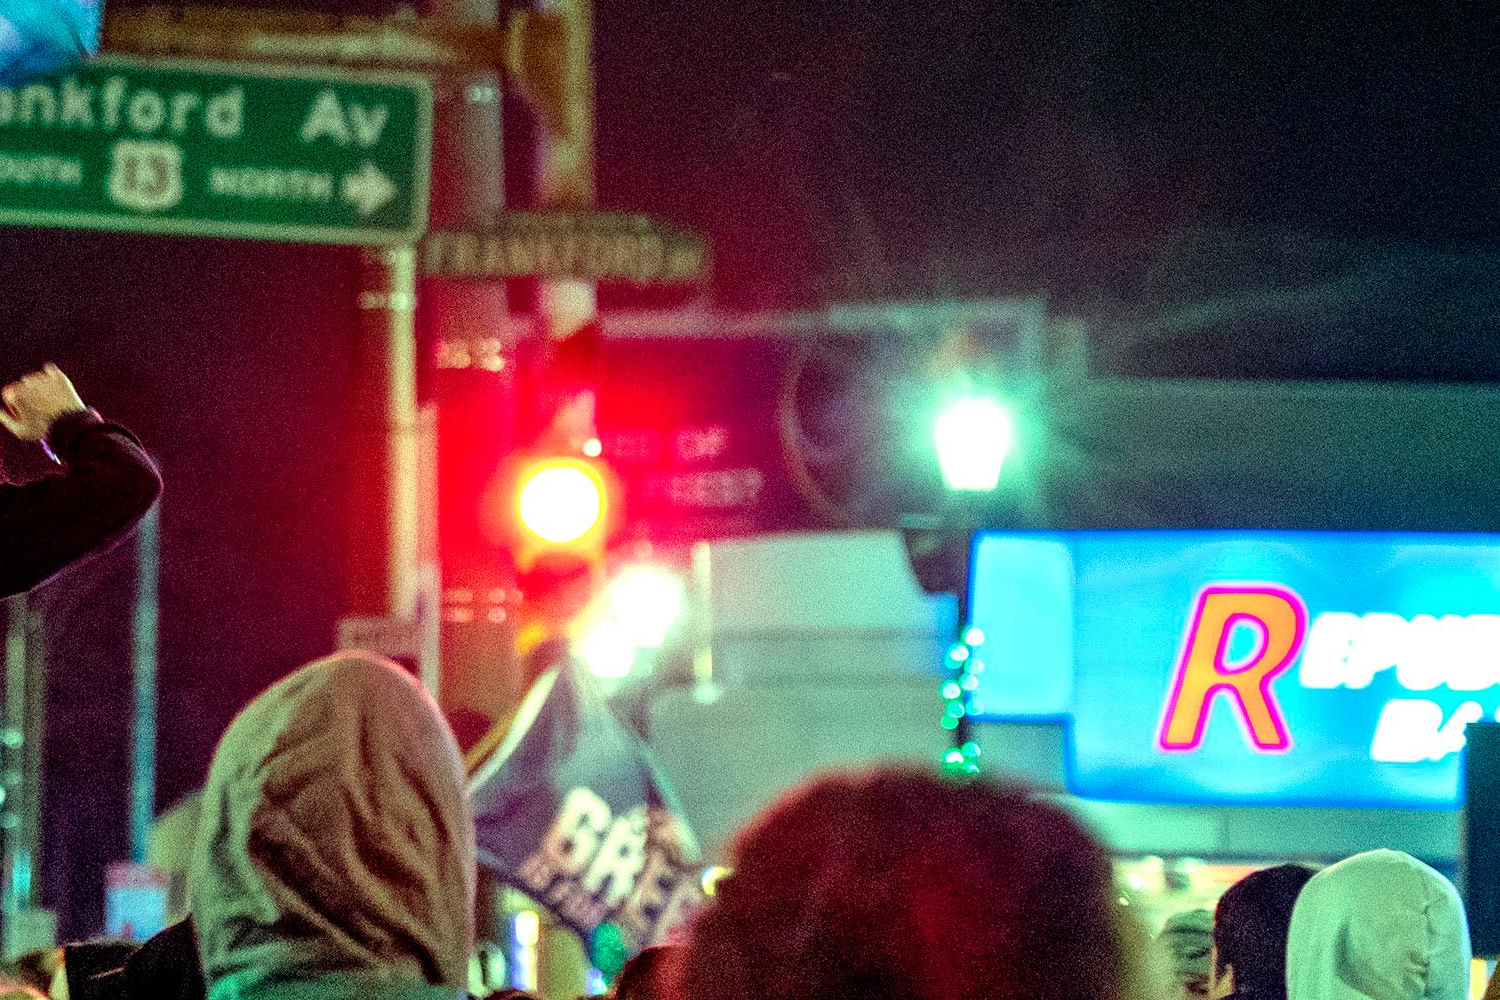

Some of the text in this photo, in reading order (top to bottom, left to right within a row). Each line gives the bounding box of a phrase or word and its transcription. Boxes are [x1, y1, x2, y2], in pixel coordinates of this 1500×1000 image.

[301, 87, 389, 146] Av
[124, 153, 171, 195] 13
[211, 168, 332, 199] NORTH
